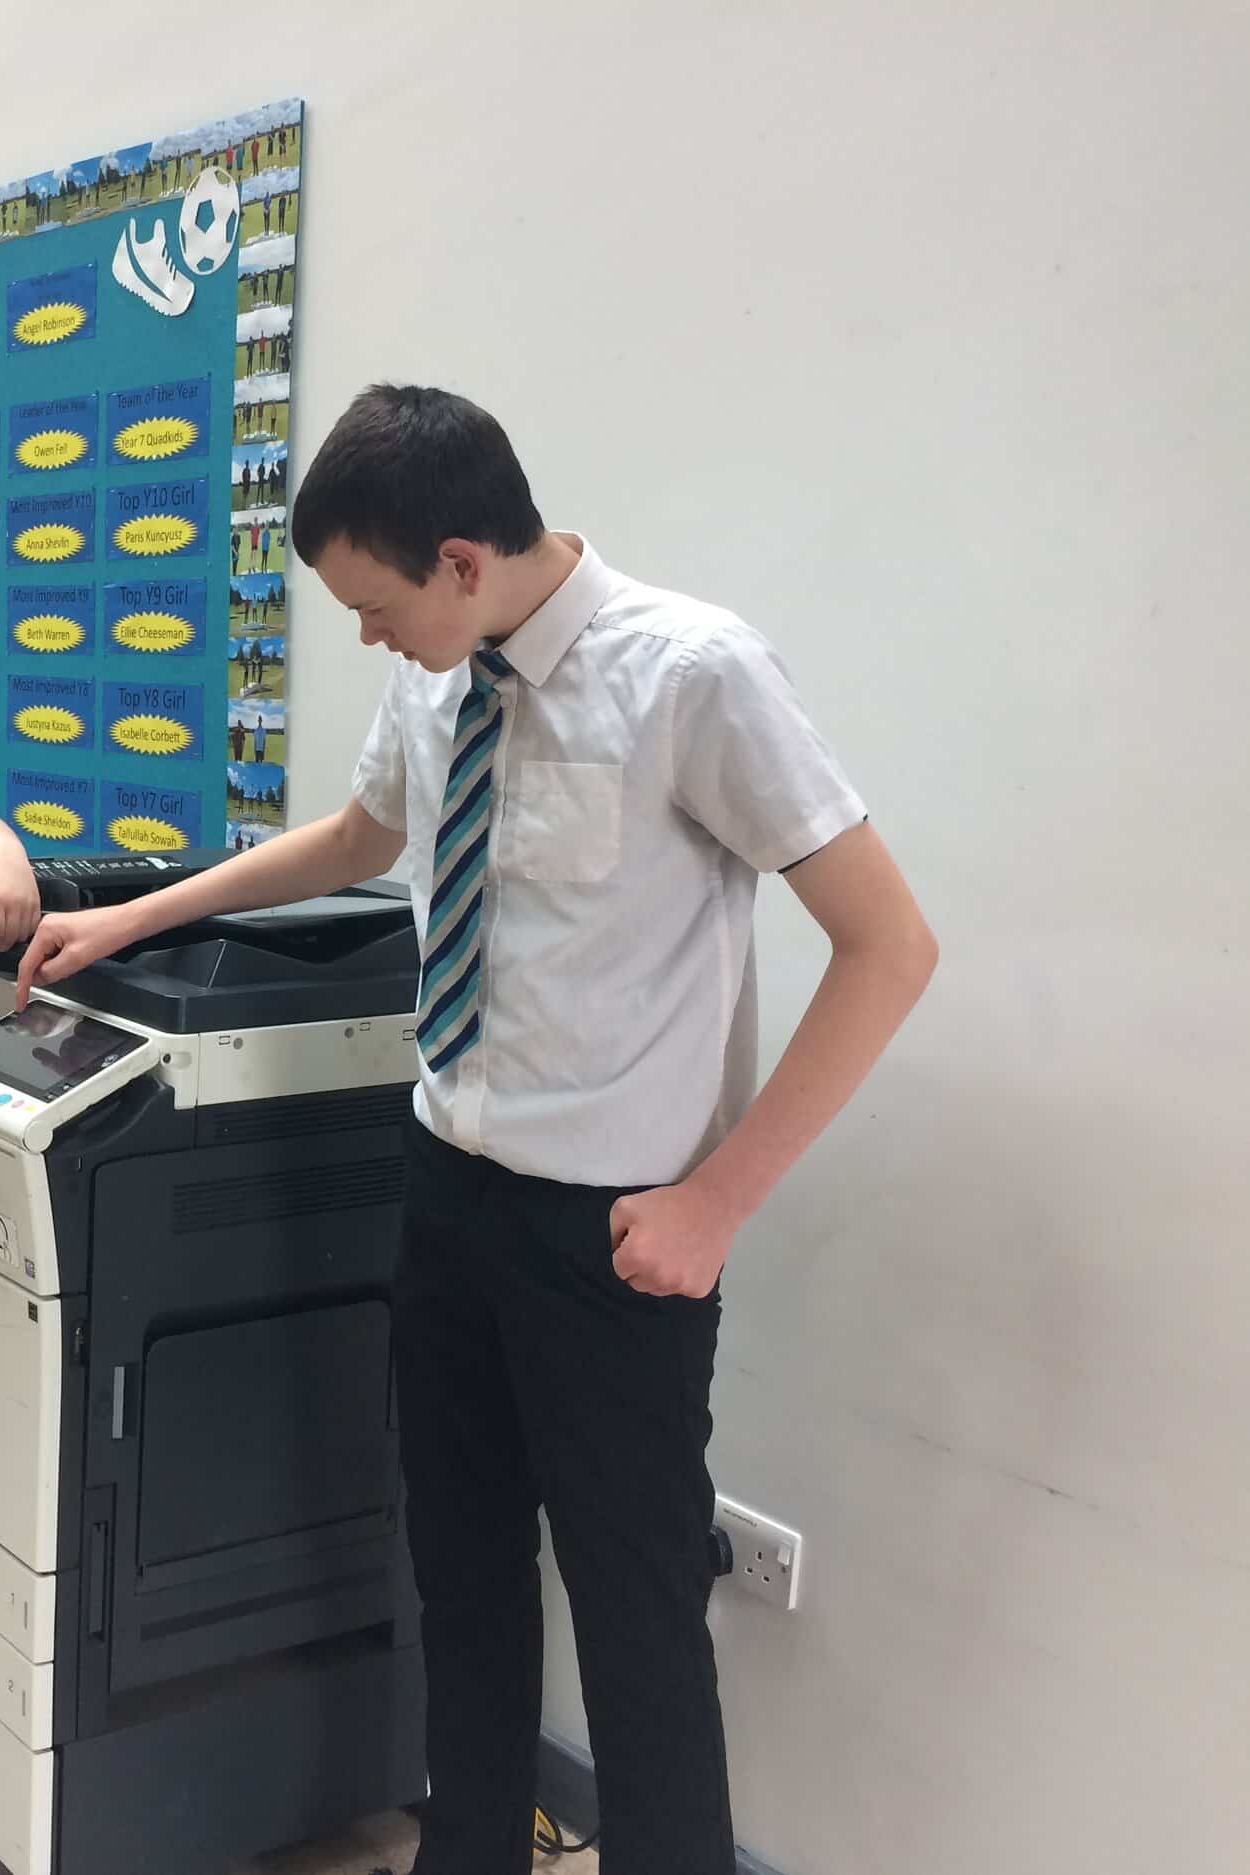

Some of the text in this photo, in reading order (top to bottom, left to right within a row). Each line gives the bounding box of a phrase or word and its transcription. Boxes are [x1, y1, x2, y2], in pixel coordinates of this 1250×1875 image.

[43, 316, 76, 332] Robinson
[118, 393, 142, 409] Team
[157, 385, 174, 403] the
[175, 383, 198, 399] Year
[120, 429, 183, 449] Year 7 Quadkids
[34, 446, 54, 457] Owen
[118, 483, 195, 514] Top Y10 Girl
[26, 538, 44, 550] Anna
[125, 531, 144, 543] Paris
[119, 584, 188, 609] Top Y9 Girl
[27, 628, 70, 640] Beth Warren
[138, 626, 183, 639] Cheeseman
[118, 687, 186, 711] Top Y8 Girl
[120, 728, 180, 743] Isabelle Corbett
[116, 787, 183, 815] Top Y7 Girl
[44, 814, 71, 829] Sheldon
[150, 832, 177, 848] Sowah
[8, 1679, 14, 1694] 2
